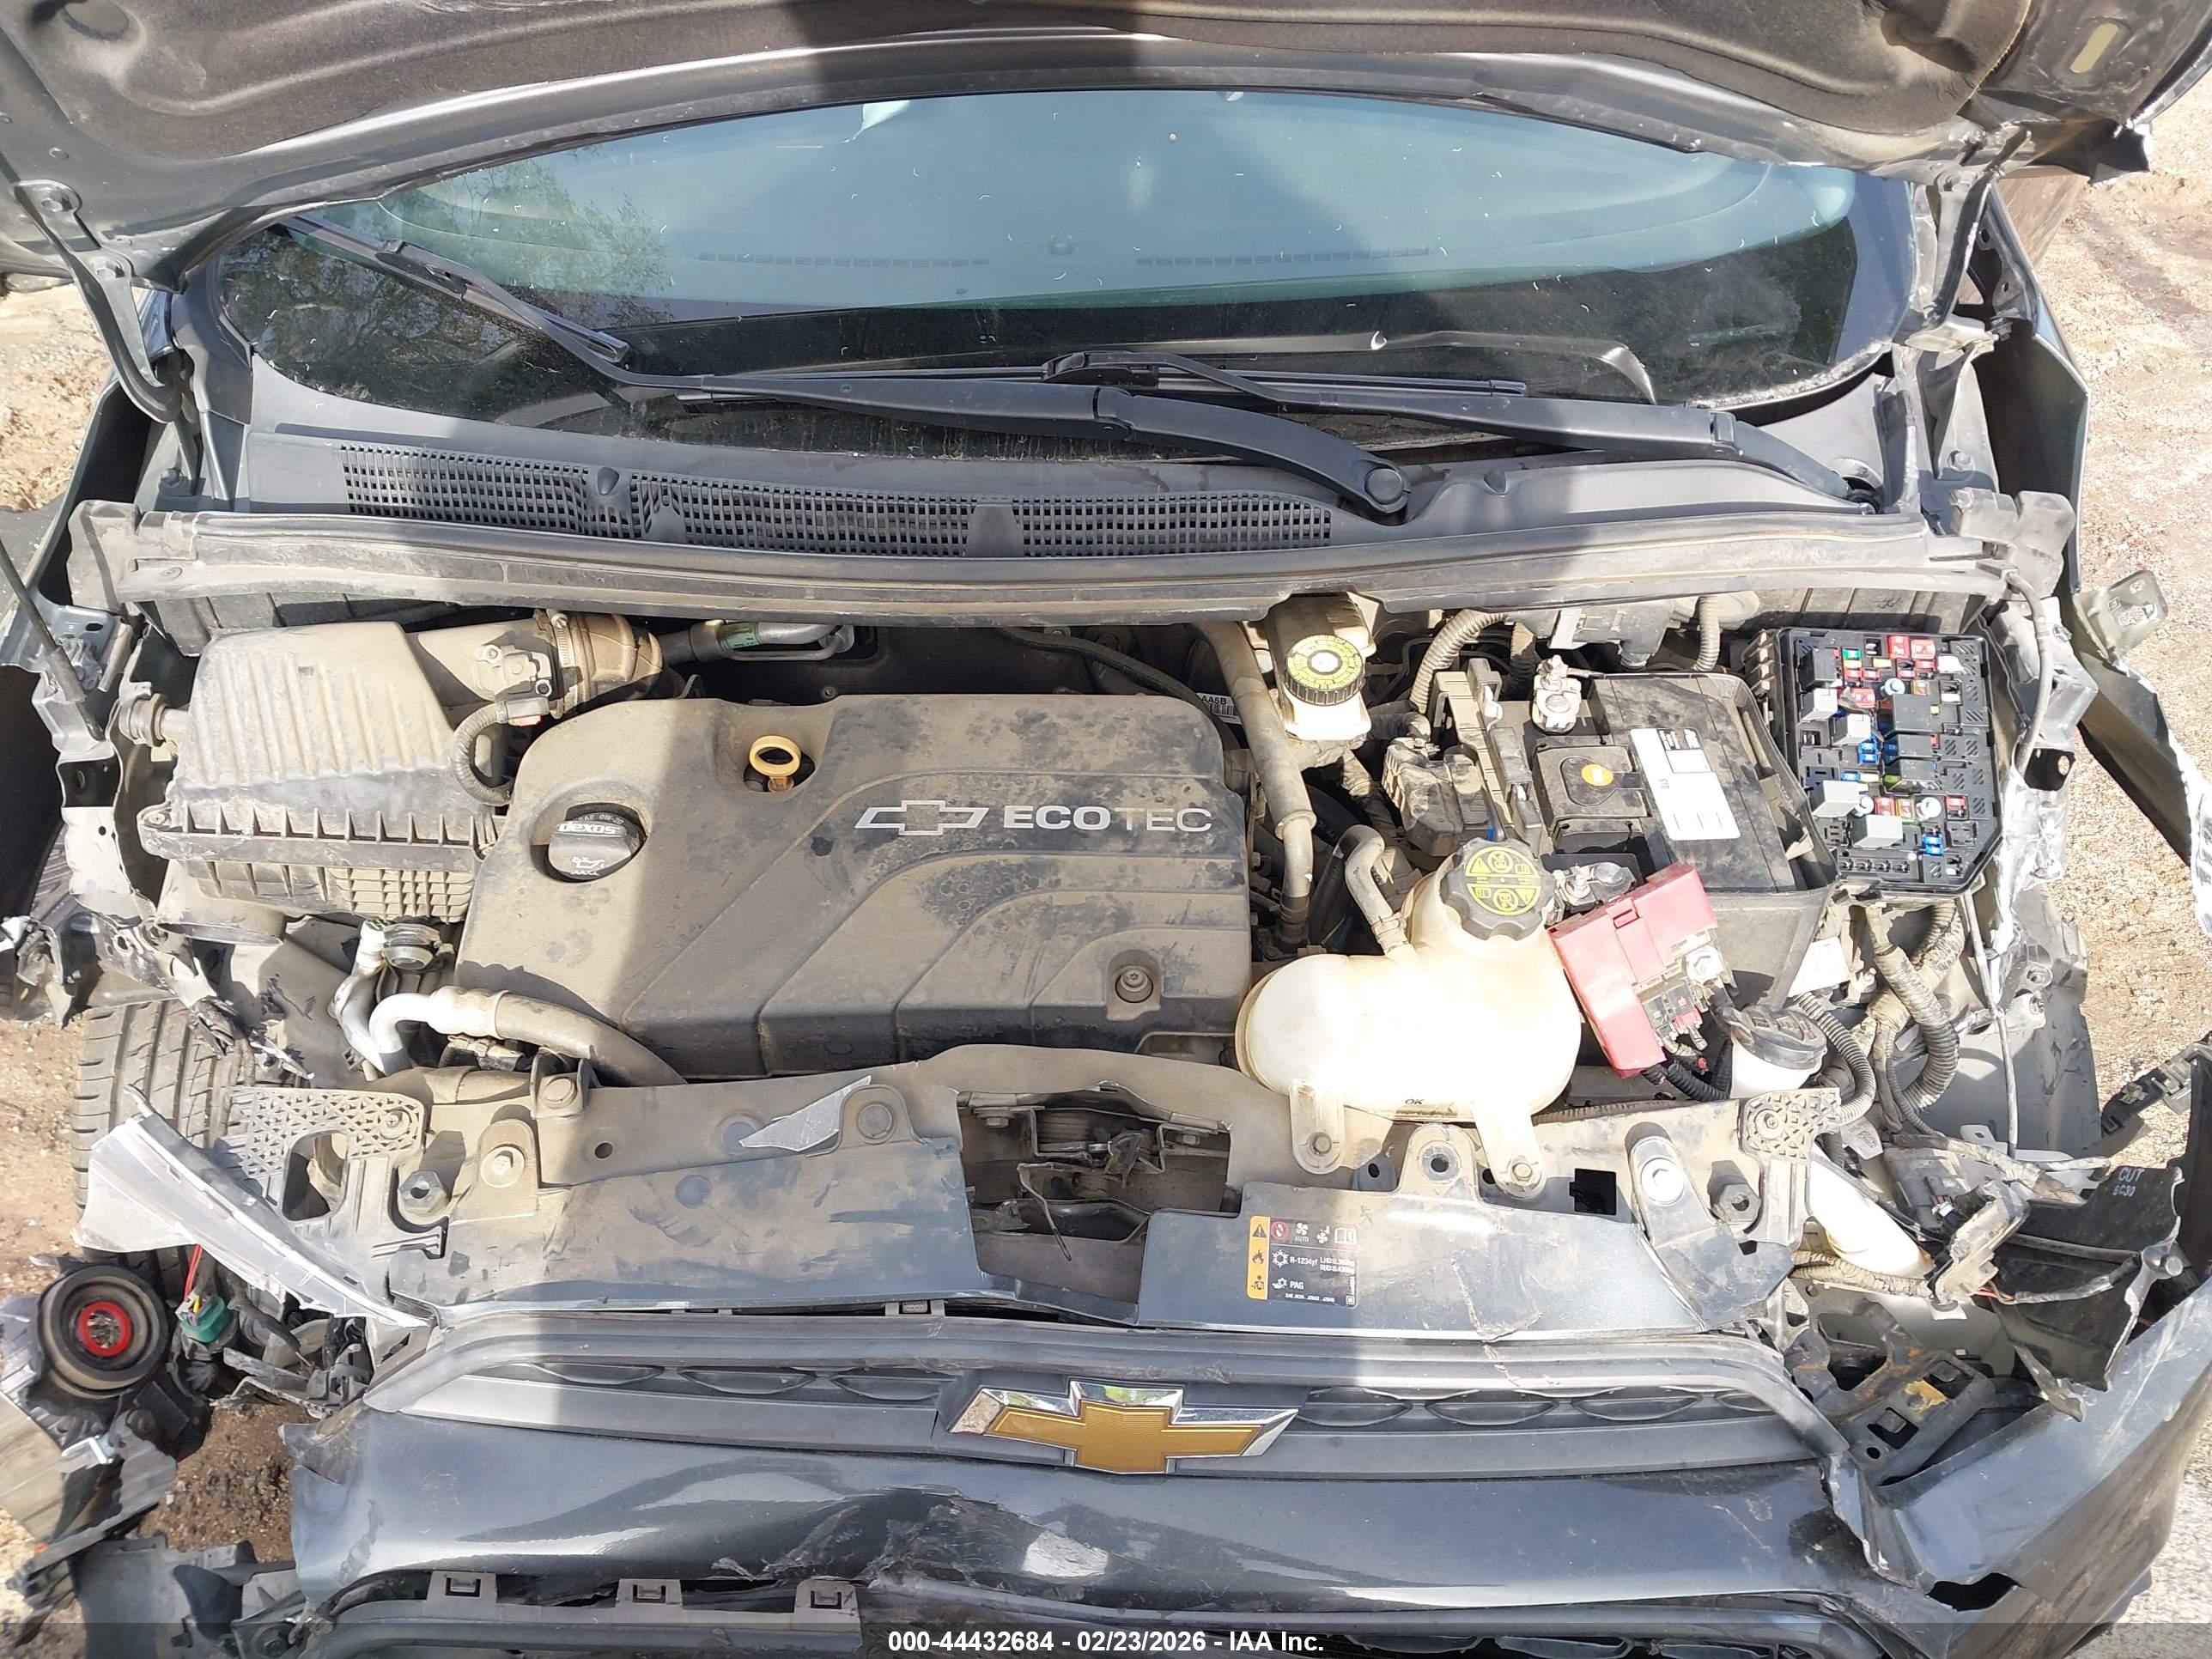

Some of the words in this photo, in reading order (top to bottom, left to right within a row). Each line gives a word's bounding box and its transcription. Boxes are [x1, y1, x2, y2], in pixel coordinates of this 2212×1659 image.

[1202, 696, 1226, 705] AA5B
[1004, 805, 1212, 833] ECOTEC
[558, 822, 621, 835] dexos
[2118, 1167, 2145, 1182] CUT
[1290, 1257, 1318, 1266] R-1234yf
[1290, 1280, 1304, 1290] PAG
